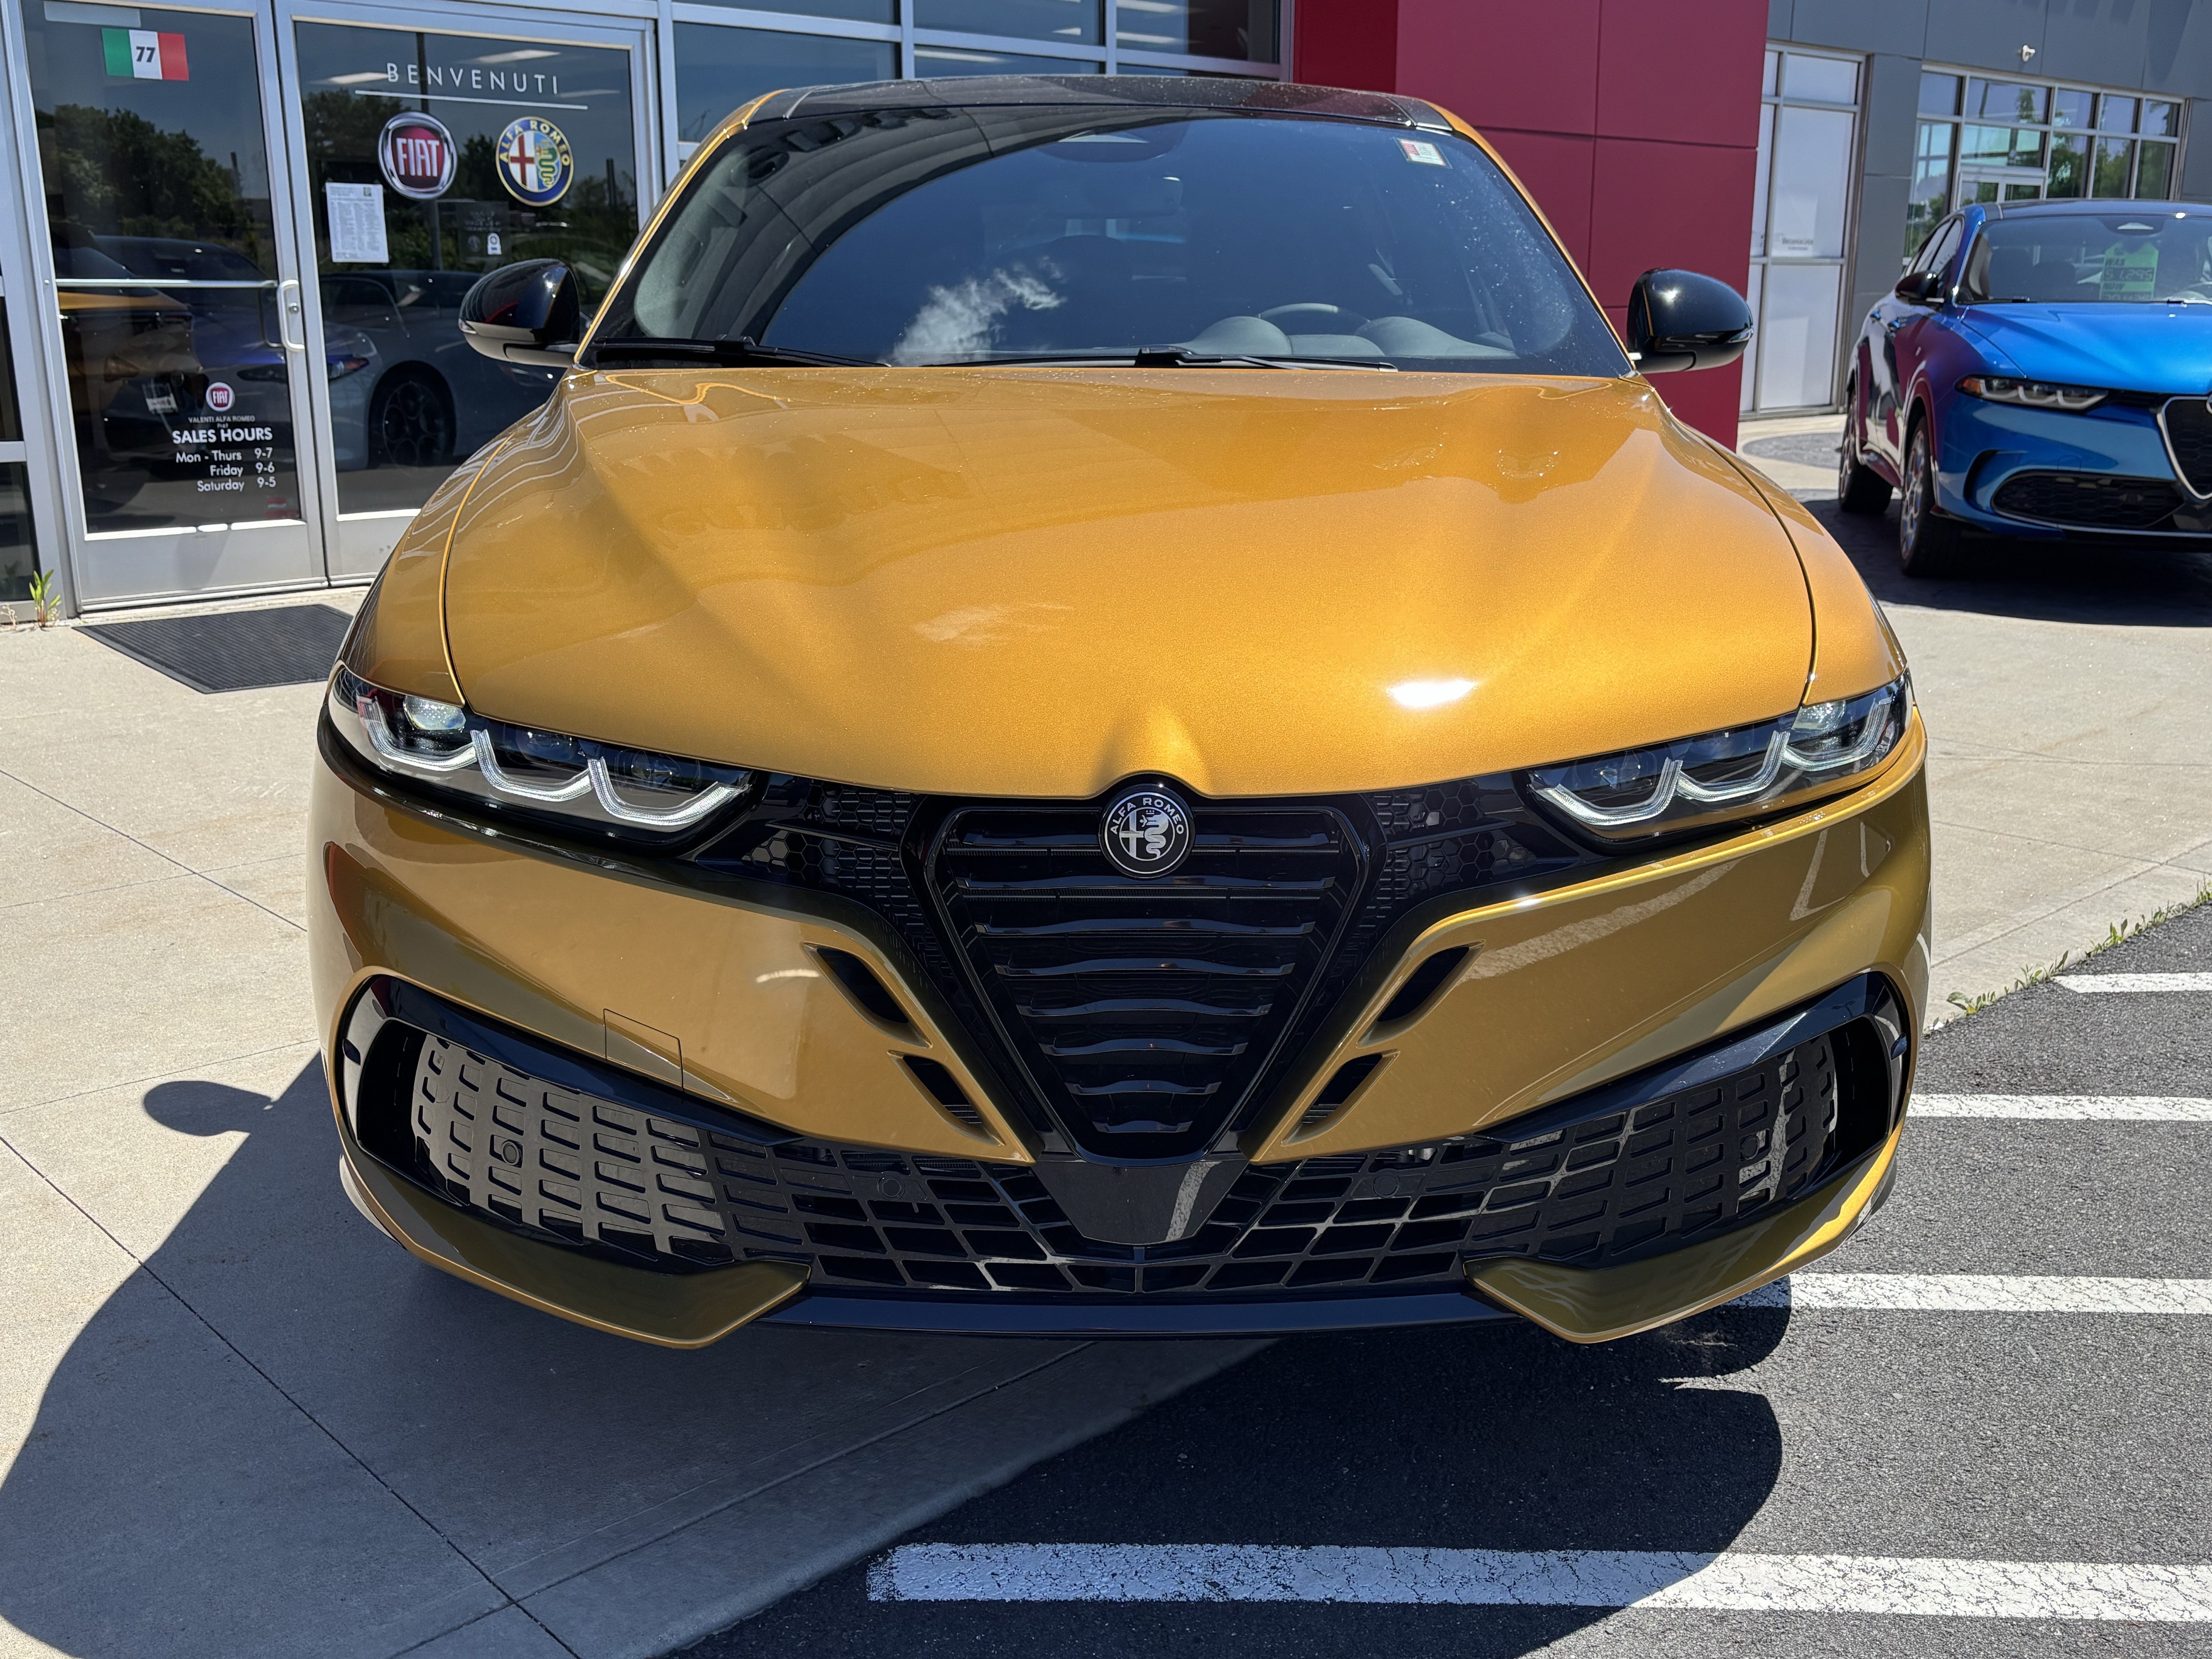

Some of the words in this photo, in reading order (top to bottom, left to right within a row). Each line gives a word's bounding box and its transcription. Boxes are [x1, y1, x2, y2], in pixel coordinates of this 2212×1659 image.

[136, 46, 156, 62] 77
[387, 63, 557, 94] BENVENUTI
[500, 124, 523, 163] ALFA
[530, 120, 570, 166] ROMEO
[396, 138, 440, 177] FIAT
[213, 390, 228, 404] FIAT
[172, 429, 217, 444] SALES
[220, 428, 273, 442] HOURS
[176, 452, 201, 463] Mon
[212, 450, 242, 461] Thurs
[254, 447, 273, 459] 9-7
[210, 464, 243, 477] Friday
[256, 462, 275, 473] 9-6
[197, 478, 244, 492] Saturday
[257, 476, 276, 488] 9-5
[1110, 802, 1136, 834] ALFA
[1143, 797, 1184, 834] ROMEO
